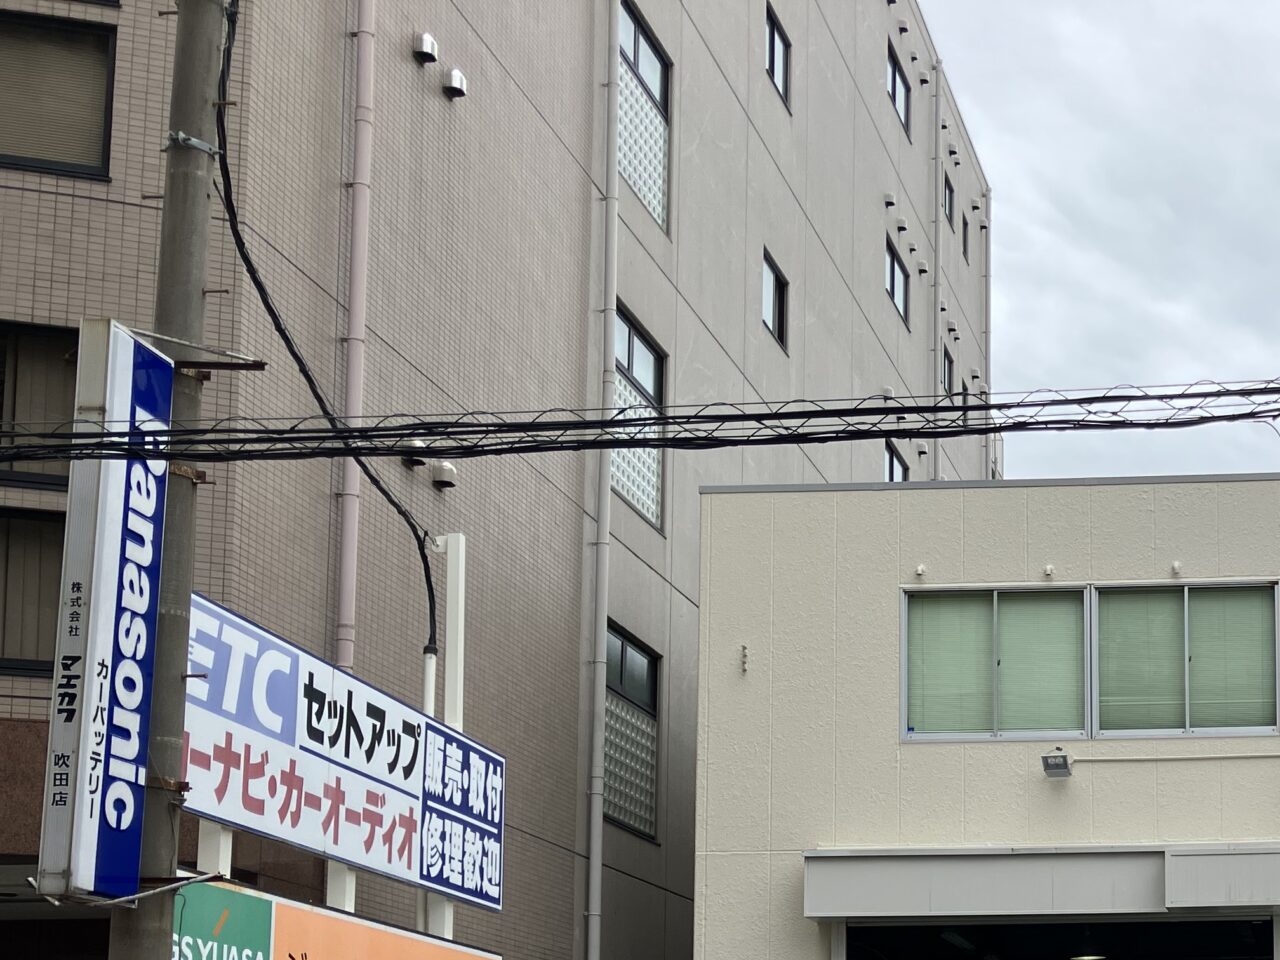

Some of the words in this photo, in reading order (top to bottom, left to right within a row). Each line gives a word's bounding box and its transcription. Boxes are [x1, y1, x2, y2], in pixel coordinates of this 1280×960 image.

[68, 581, 83, 637] 株式会社
[105, 404, 168, 831] Panasonic
[88, 658, 108, 819] カーバッテリー
[303, 670, 422, 781] セットアップ
[51, 752, 71, 807] 吹田店
[424, 729, 502, 824] 販売・取付
[422, 810, 501, 899] 修理歓迎
